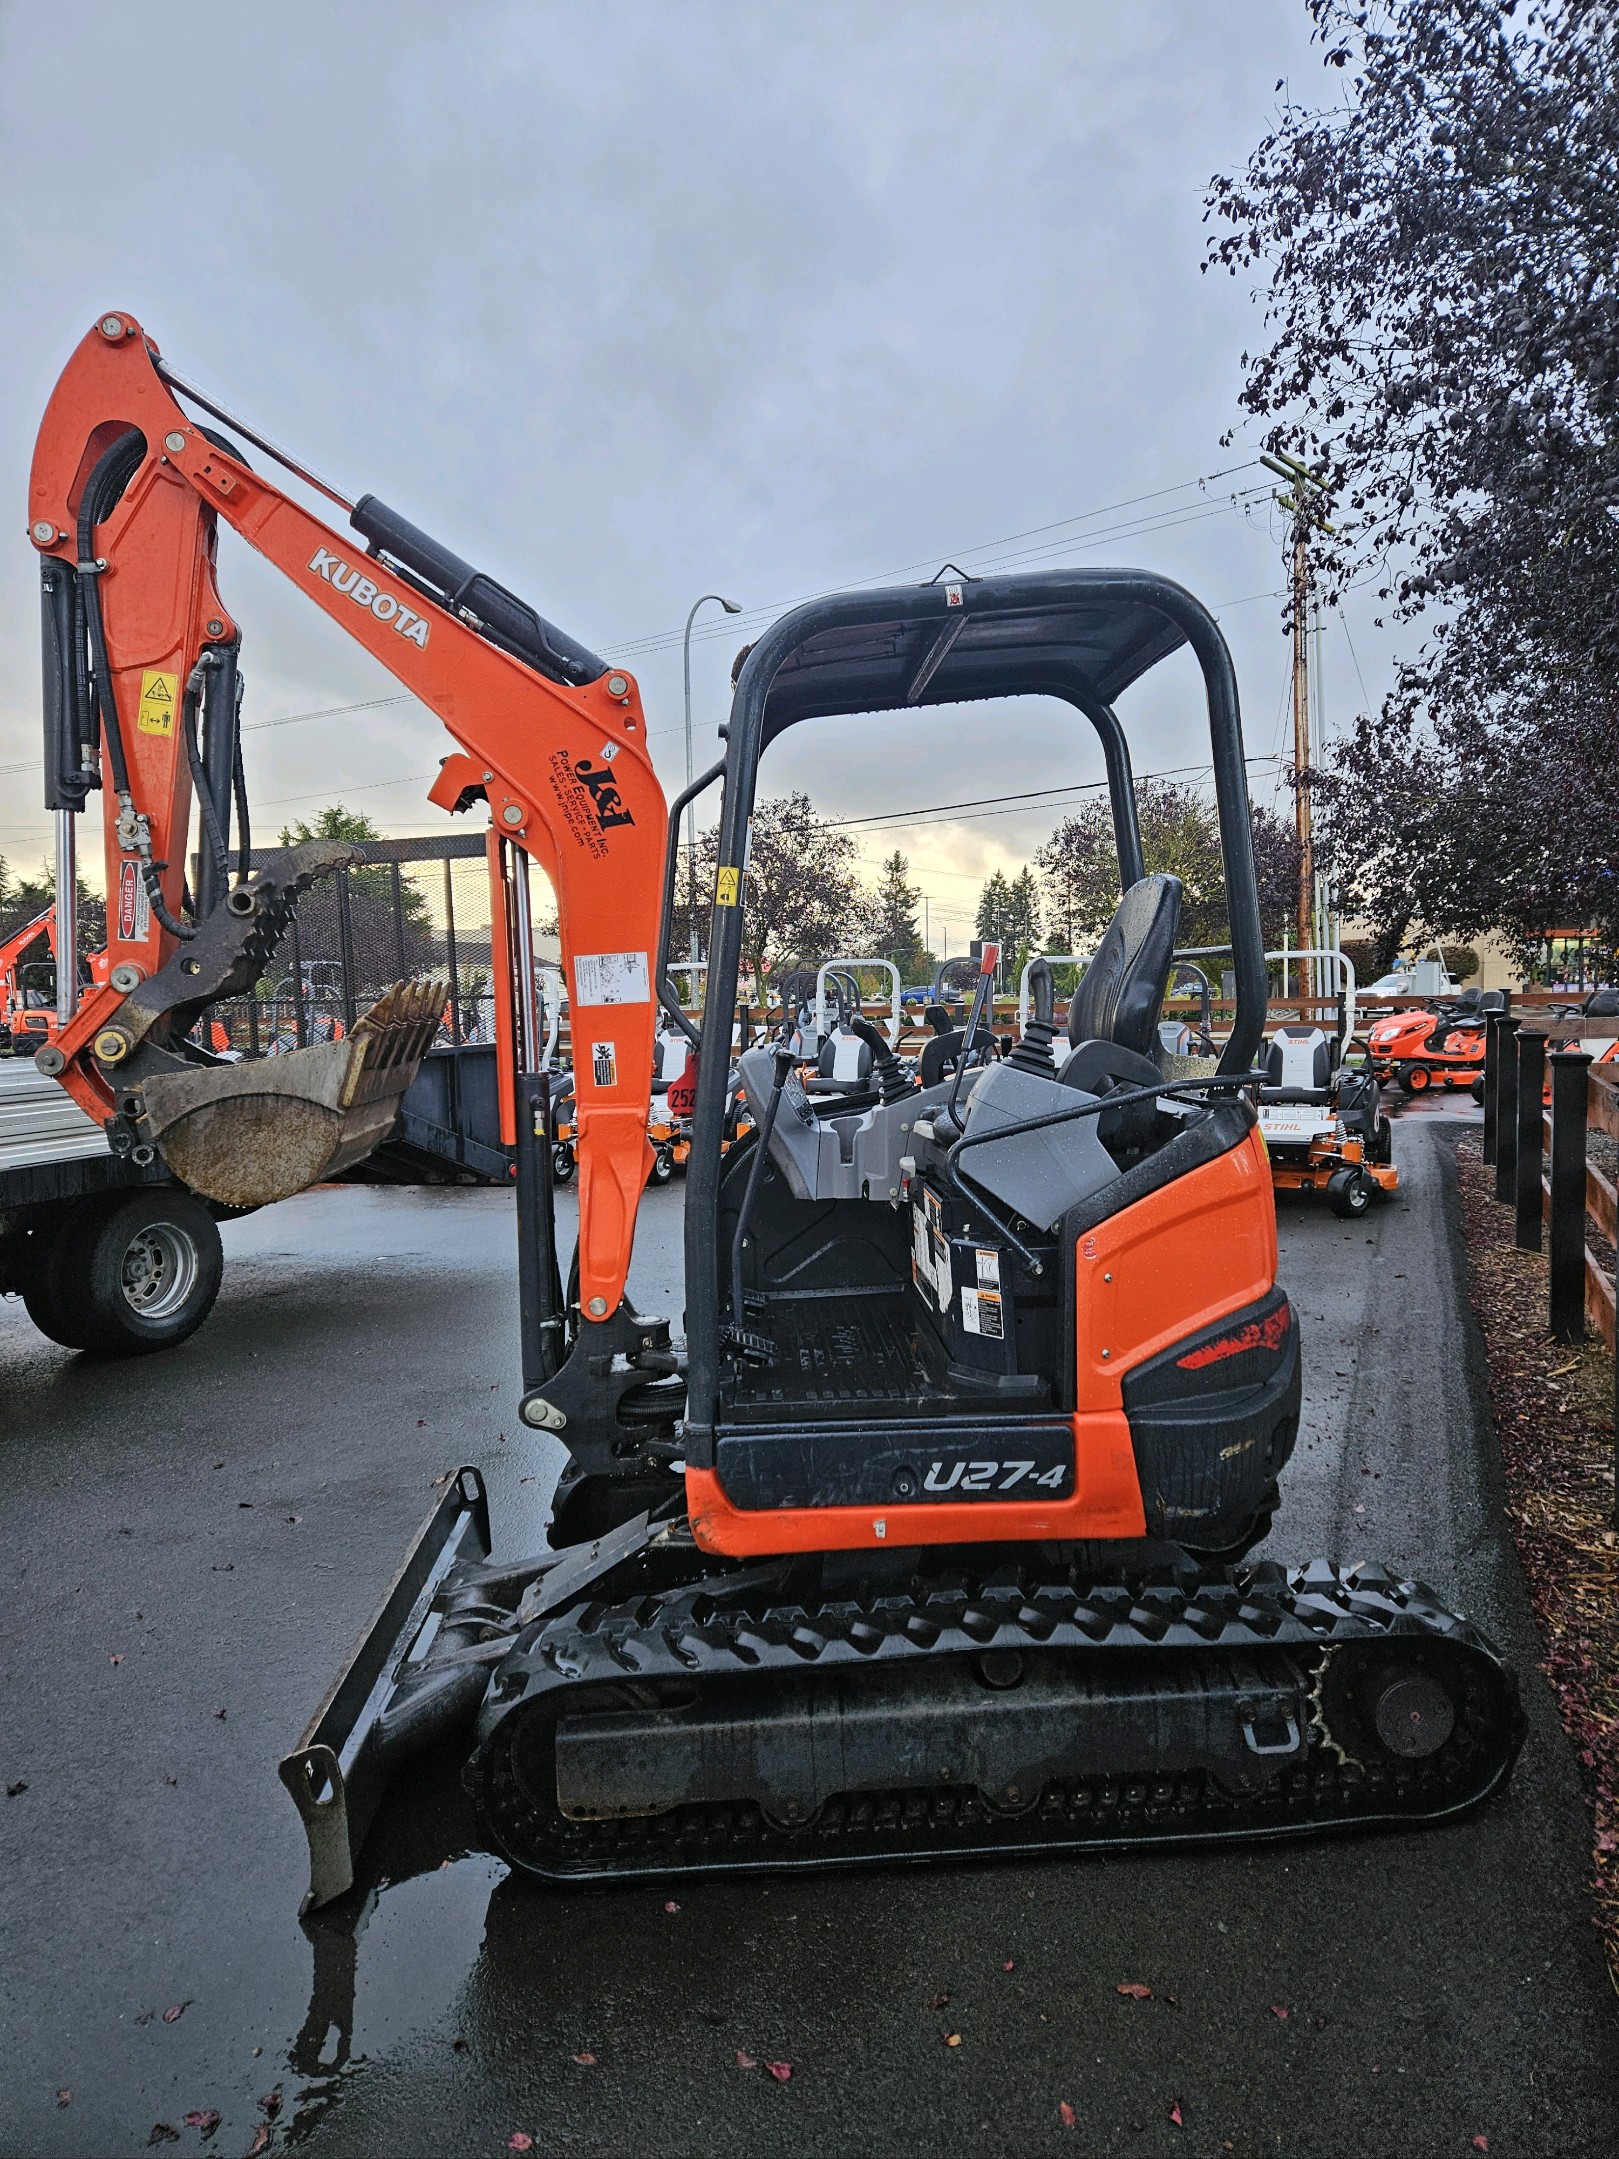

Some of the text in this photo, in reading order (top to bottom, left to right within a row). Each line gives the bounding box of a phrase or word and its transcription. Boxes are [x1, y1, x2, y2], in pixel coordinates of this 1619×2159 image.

[308, 546, 430, 648] KUBOTA
[549, 755, 601, 860] SALES SERVICE PARTS
[549, 775, 586, 847] www.jnipe.com
[557, 750, 609, 858] POWER EQUIPMENT INC.
[124, 880, 134, 922] DANGER
[1263, 1123, 1301, 1131] STIHL
[923, 1460, 1067, 1491] U27-4
